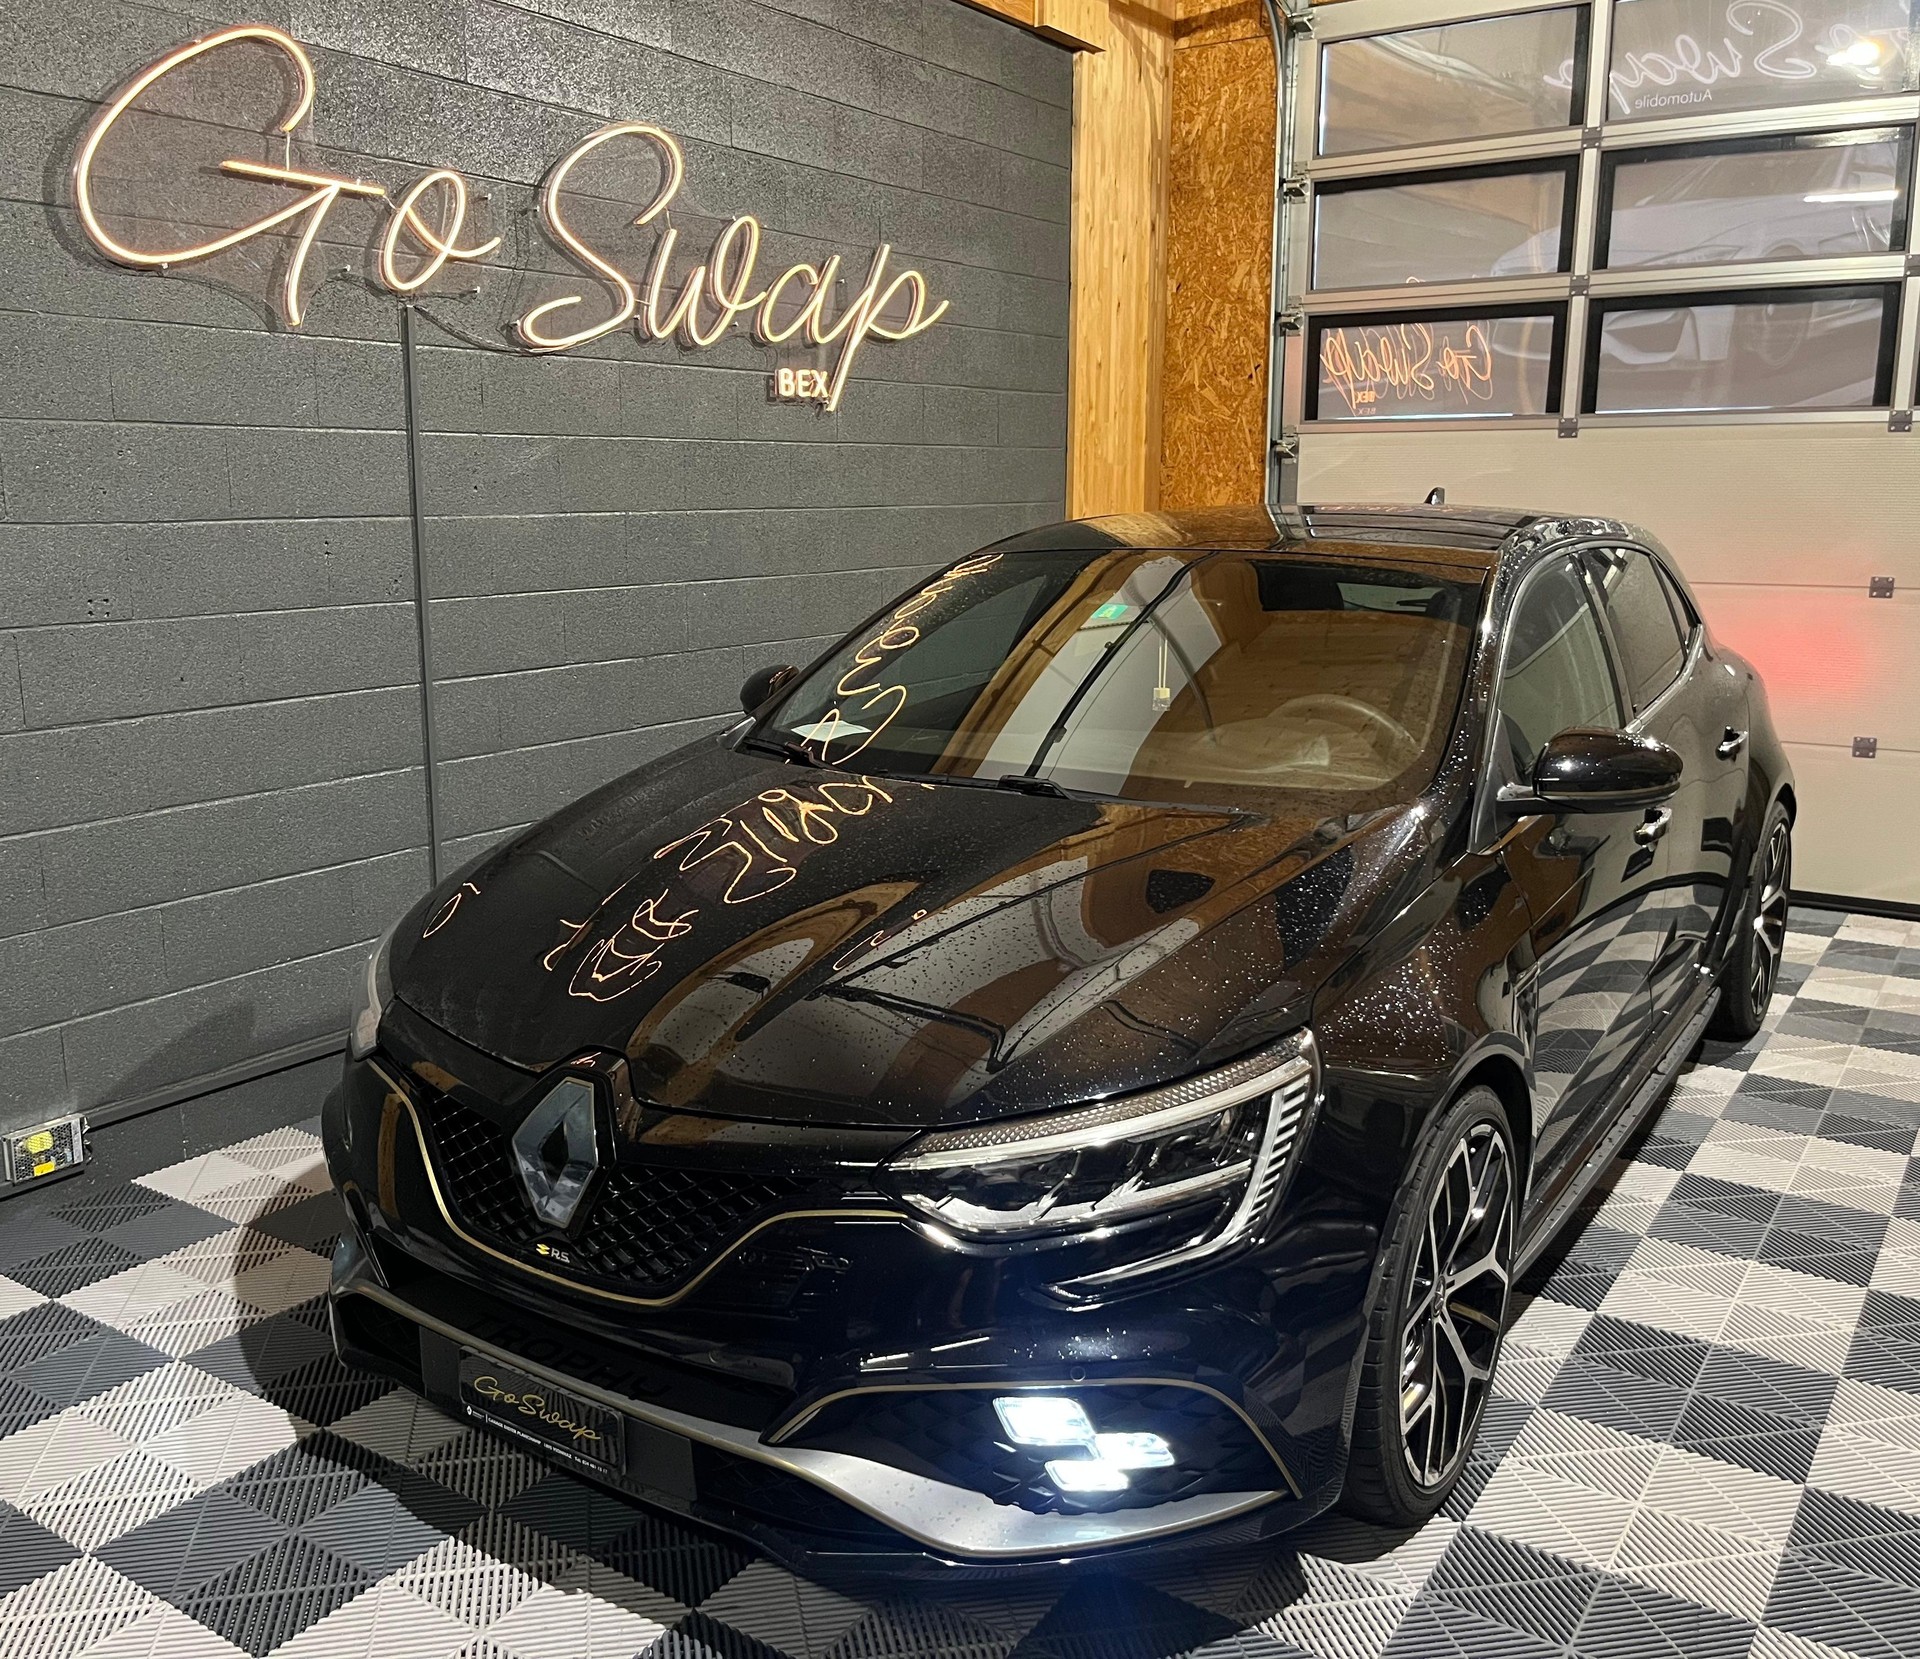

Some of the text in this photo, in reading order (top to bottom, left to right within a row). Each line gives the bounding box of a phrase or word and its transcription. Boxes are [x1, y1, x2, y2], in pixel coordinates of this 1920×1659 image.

[72, 23, 950, 412] Go Swap
[775, 367, 830, 398] BEX
